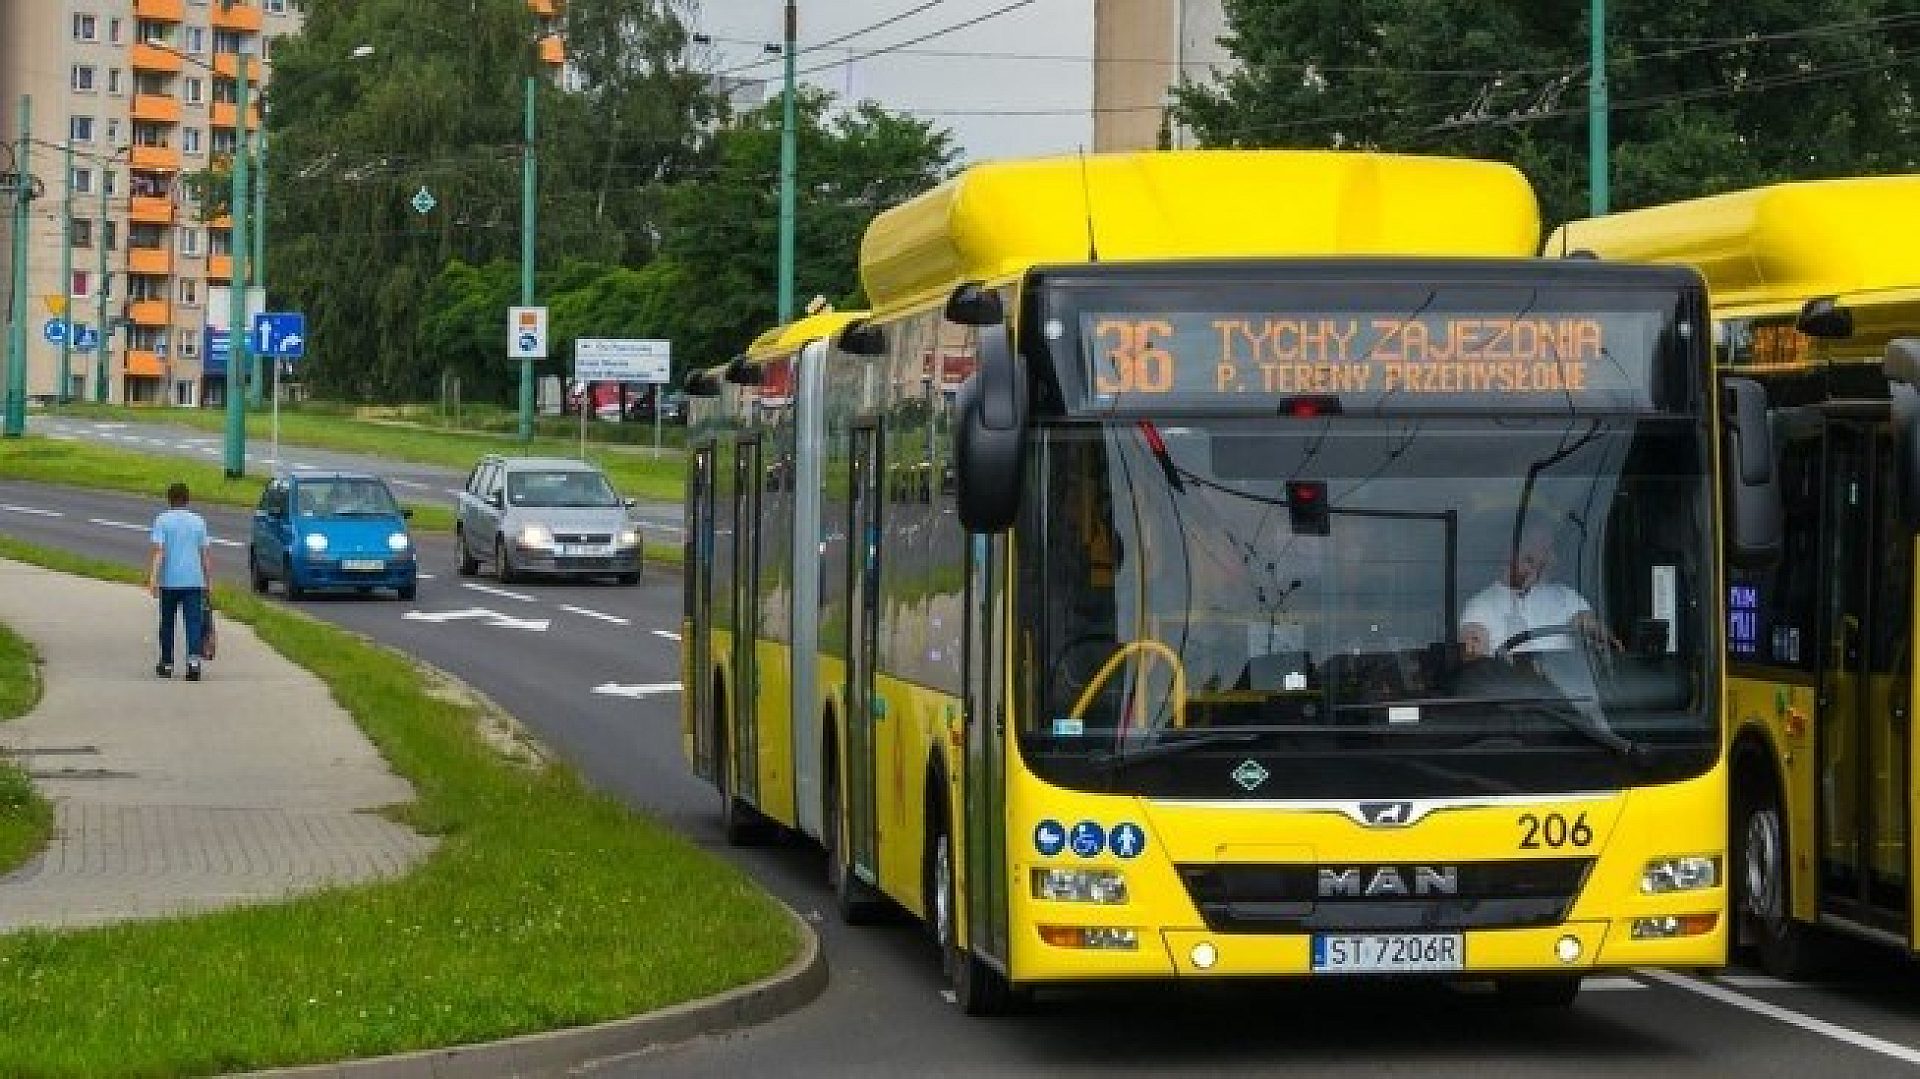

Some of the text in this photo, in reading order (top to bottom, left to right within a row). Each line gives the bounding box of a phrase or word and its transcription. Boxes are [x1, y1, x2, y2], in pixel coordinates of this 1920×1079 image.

[1096, 319, 1174, 393] 36
[1211, 319, 1602, 361] TYCHY ZAJEZDNIA
[1217, 362, 1588, 393] P. TERENY PRZEMYSŁOWE
[1518, 811, 1593, 849] 206
[1317, 866, 1458, 897] MAN
[1332, 936, 1455, 964] ST 7206R
